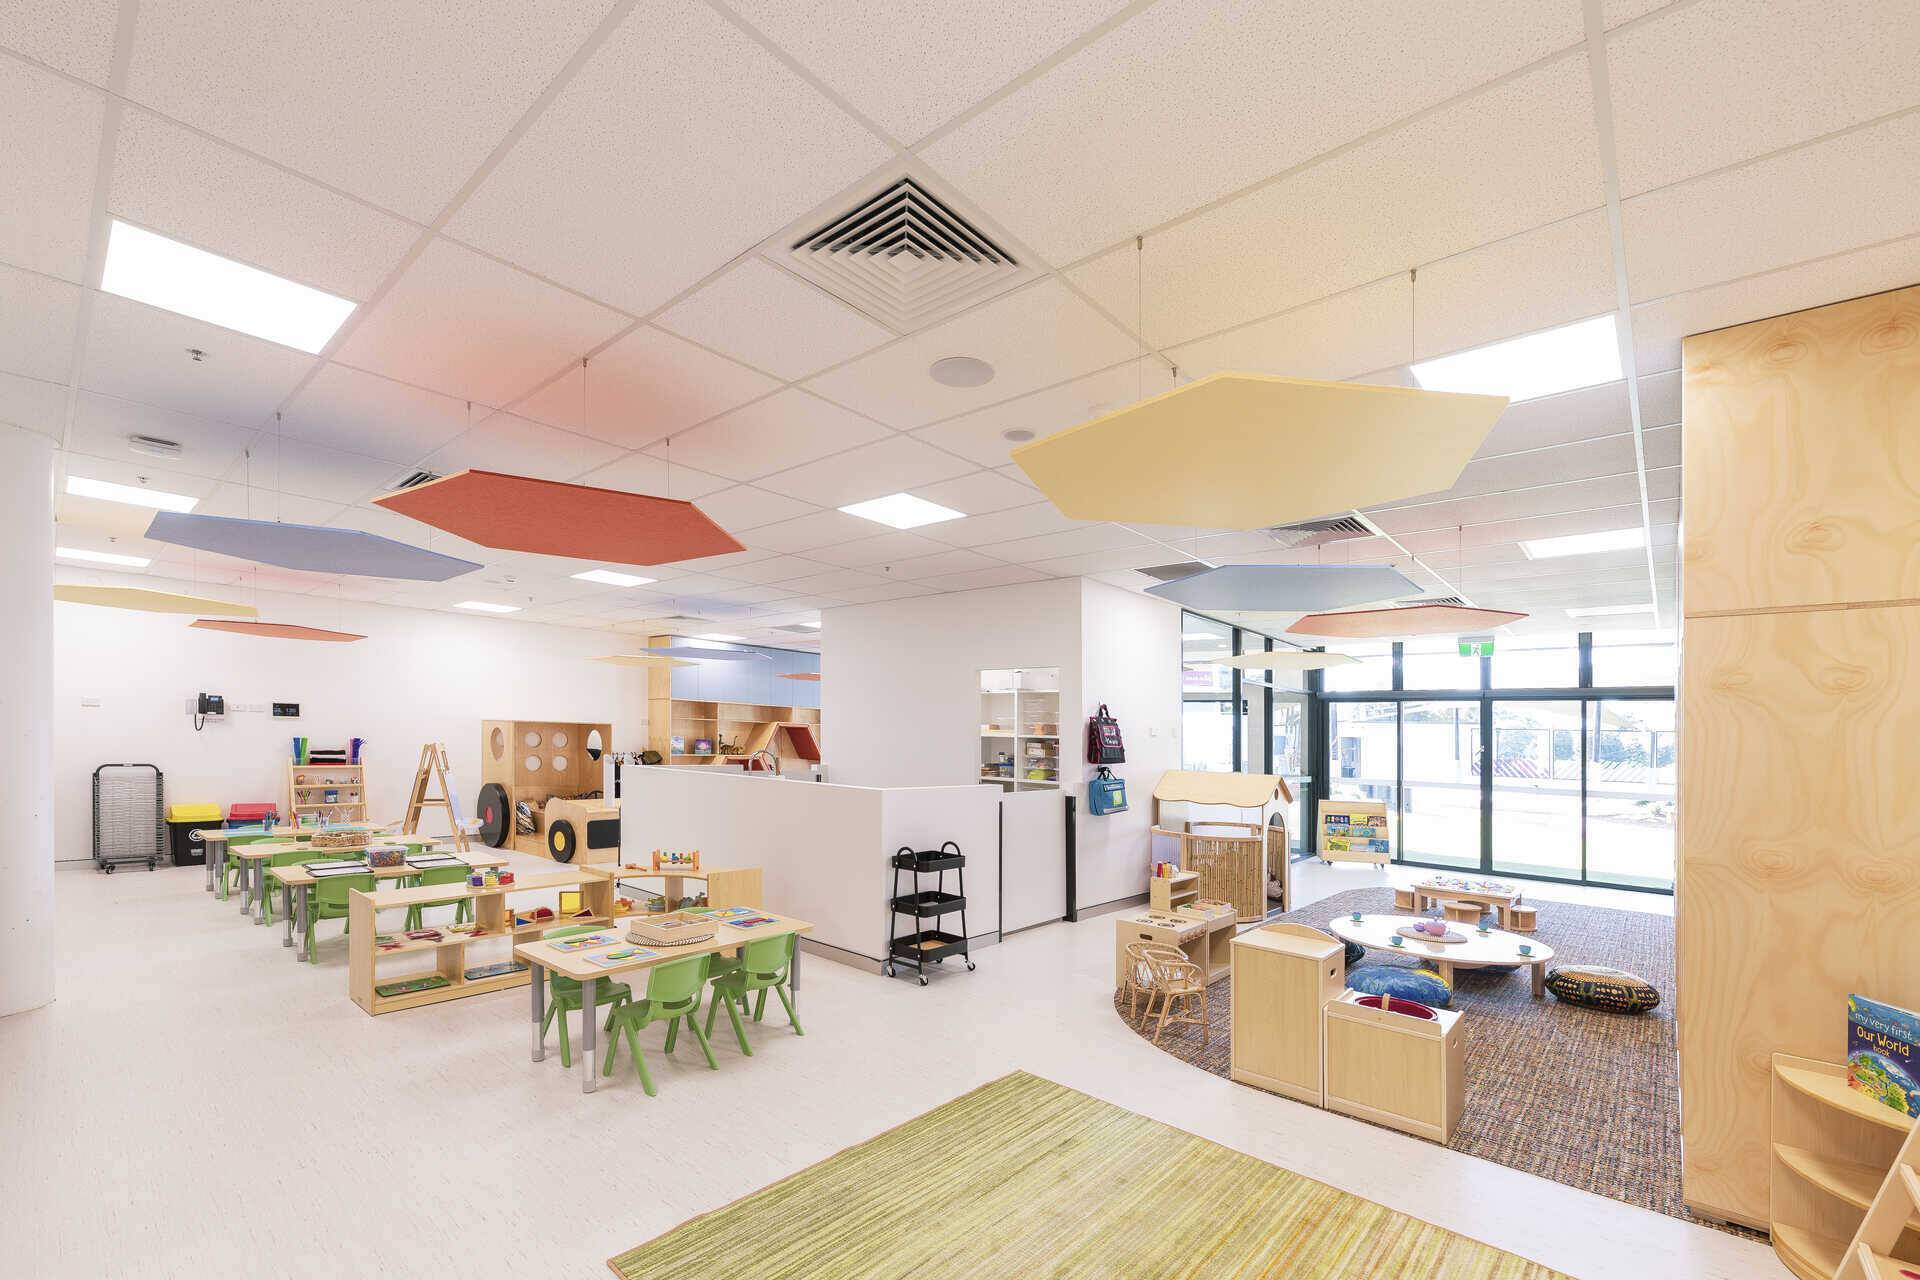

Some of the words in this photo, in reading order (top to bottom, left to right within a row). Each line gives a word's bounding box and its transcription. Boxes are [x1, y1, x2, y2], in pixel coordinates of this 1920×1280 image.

[1855, 1013, 1868, 1025] my
[1870, 1018, 1890, 1033] very
[1891, 1025, 1912, 1040] first
[1857, 1026, 1875, 1041] Our
[1877, 1032, 1909, 1057] World
[1873, 1043, 1890, 1057] book
